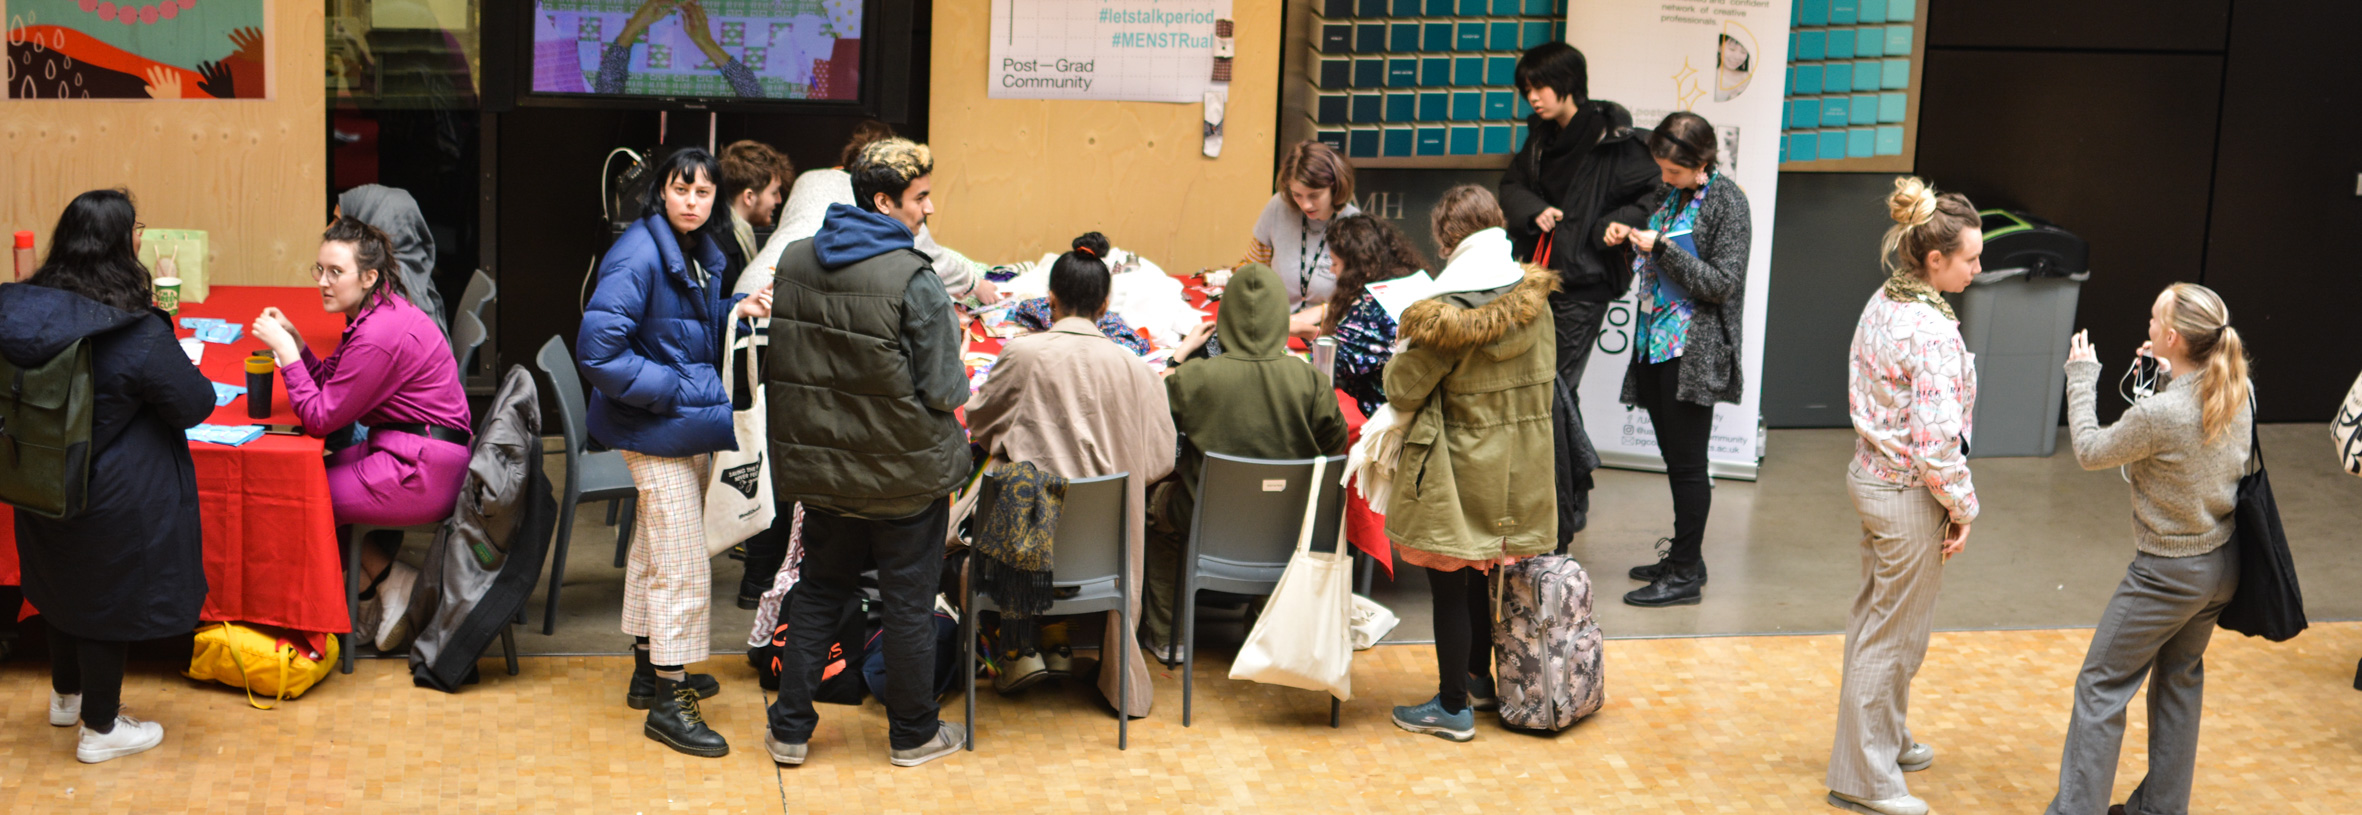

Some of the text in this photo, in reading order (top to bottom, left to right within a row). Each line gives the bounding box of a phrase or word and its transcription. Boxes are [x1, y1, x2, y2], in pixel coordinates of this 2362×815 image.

[1099, 8, 1215, 28] #letstalkperiod
[1661, 4, 1747, 17] network of creative
[1112, 32, 1214, 48] #MENSTRual
[1002, 74, 1093, 91] Community
